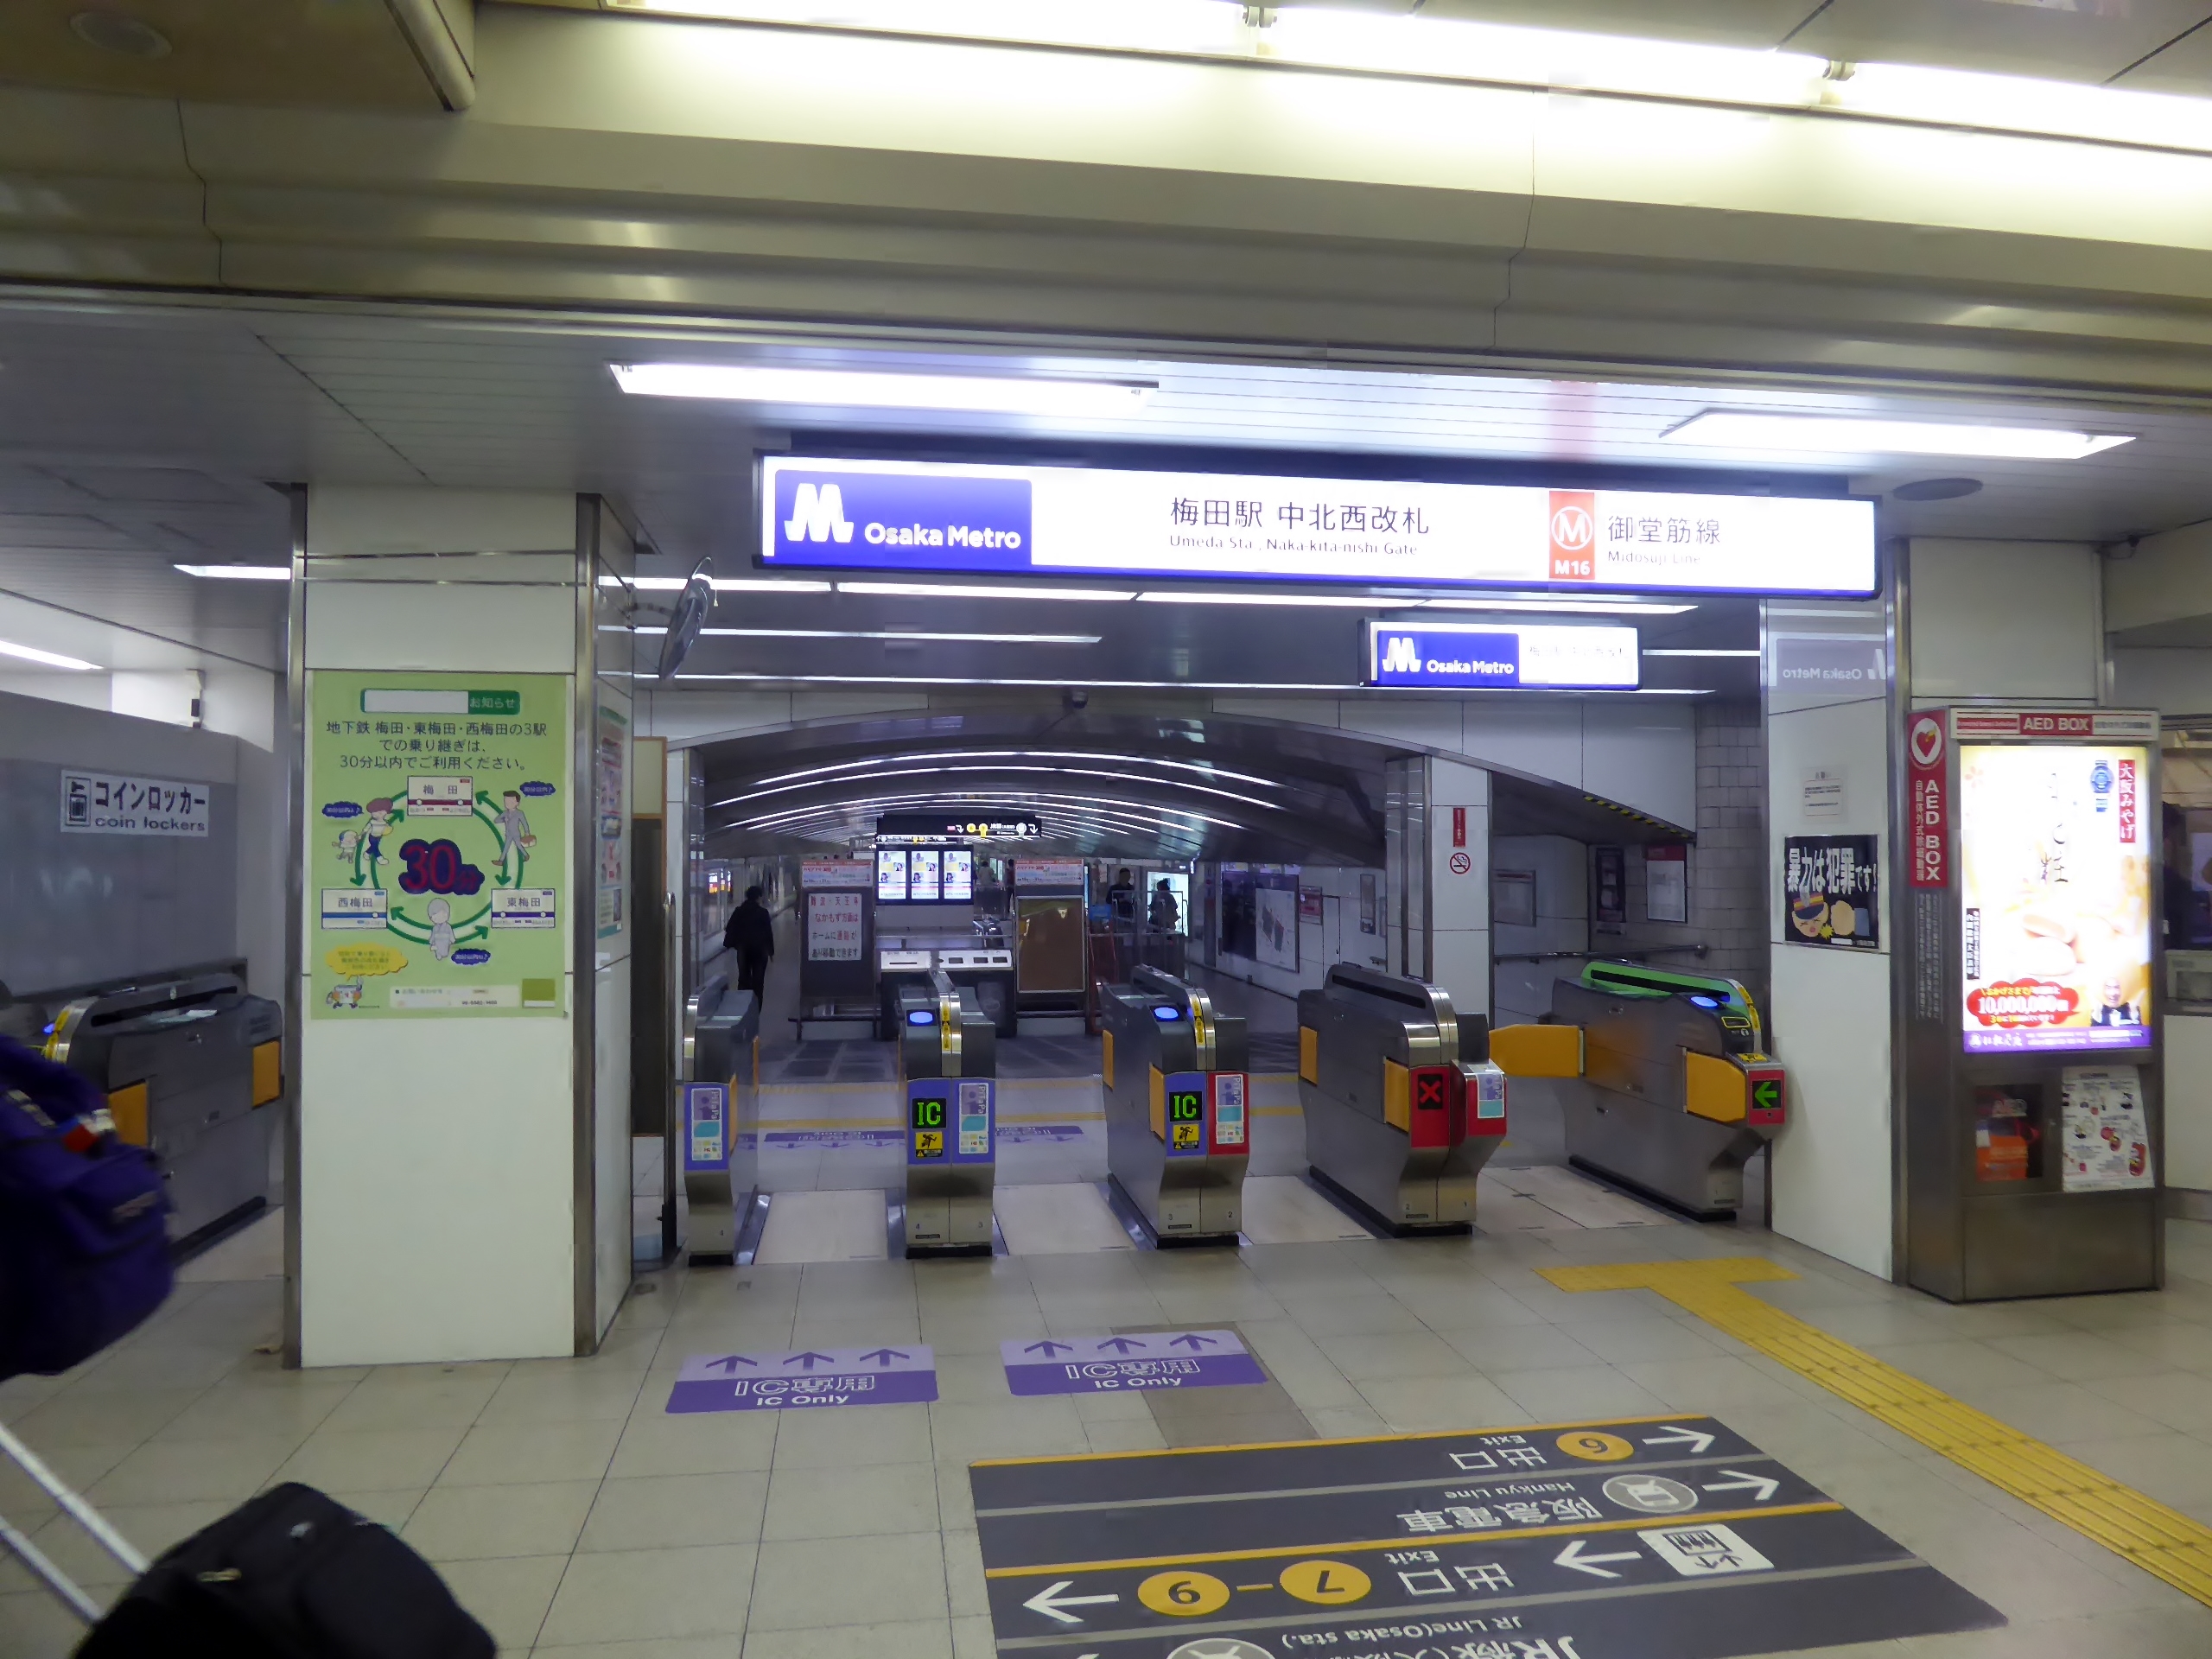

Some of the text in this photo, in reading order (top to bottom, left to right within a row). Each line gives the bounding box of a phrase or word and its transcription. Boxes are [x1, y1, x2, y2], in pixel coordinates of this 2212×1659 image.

[1171, 497, 1429, 534] 梅田駅 中北西改札
[864, 523, 1021, 550] Osaka Metro
[1607, 515, 1721, 544] 御堂筋線
[1170, 534, 1223, 548] Umeda
[1267, 537, 1379, 555] Naka-kita-nishi
[1384, 542, 1417, 556] Gate
[1555, 559, 1591, 575] M16
[1607, 550, 1668, 565] Midosuji
[1427, 658, 1514, 675] Osaka Metro
[470, 696, 516, 709] お知らせ
[327, 721, 547, 736] 地下鉄 梅田・東梅田・西梅田の3駅
[2023, 717, 2053, 731] AED
[2058, 717, 2090, 731] BOX
[379, 739, 486, 753] での乗り継ぎは、
[340, 754, 526, 771] 30分以内でご利用ください。
[95, 781, 206, 815] コインロッカー
[423, 784, 458, 795] 梅田
[1925, 779, 1940, 825] AED
[2120, 762, 2135, 840] 大阪みやげ
[94, 814, 206, 832] coin lockers
[1925, 835, 1942, 880] BOX
[404, 844, 476, 891] 30分
[1787, 846, 1878, 895] 暴力は犯罪です!
[338, 897, 373, 908] 西梅田
[506, 897, 541, 907] 東梅田
[917, 1101, 941, 1126] IC
[1173, 1095, 1197, 1118] IC
[1065, 1358, 1201, 1380] IC専用
[734, 1375, 875, 1396] IC専用
[1094, 1376, 1181, 1389] IC Only
[756, 1394, 849, 1406] IC Only
[1479, 1434, 1527, 1446] Exit
[1449, 1446, 1548, 1471] 出口
[1444, 1482, 1576, 1500] Hankyu Line
[1396, 1497, 1604, 1533] 阪急電車
[1384, 1550, 1440, 1567] Exit
[1315, 1569, 1346, 1594] 7
[1398, 1562, 1516, 1598] 出口
[1491, 1615, 1522, 1630] JR
